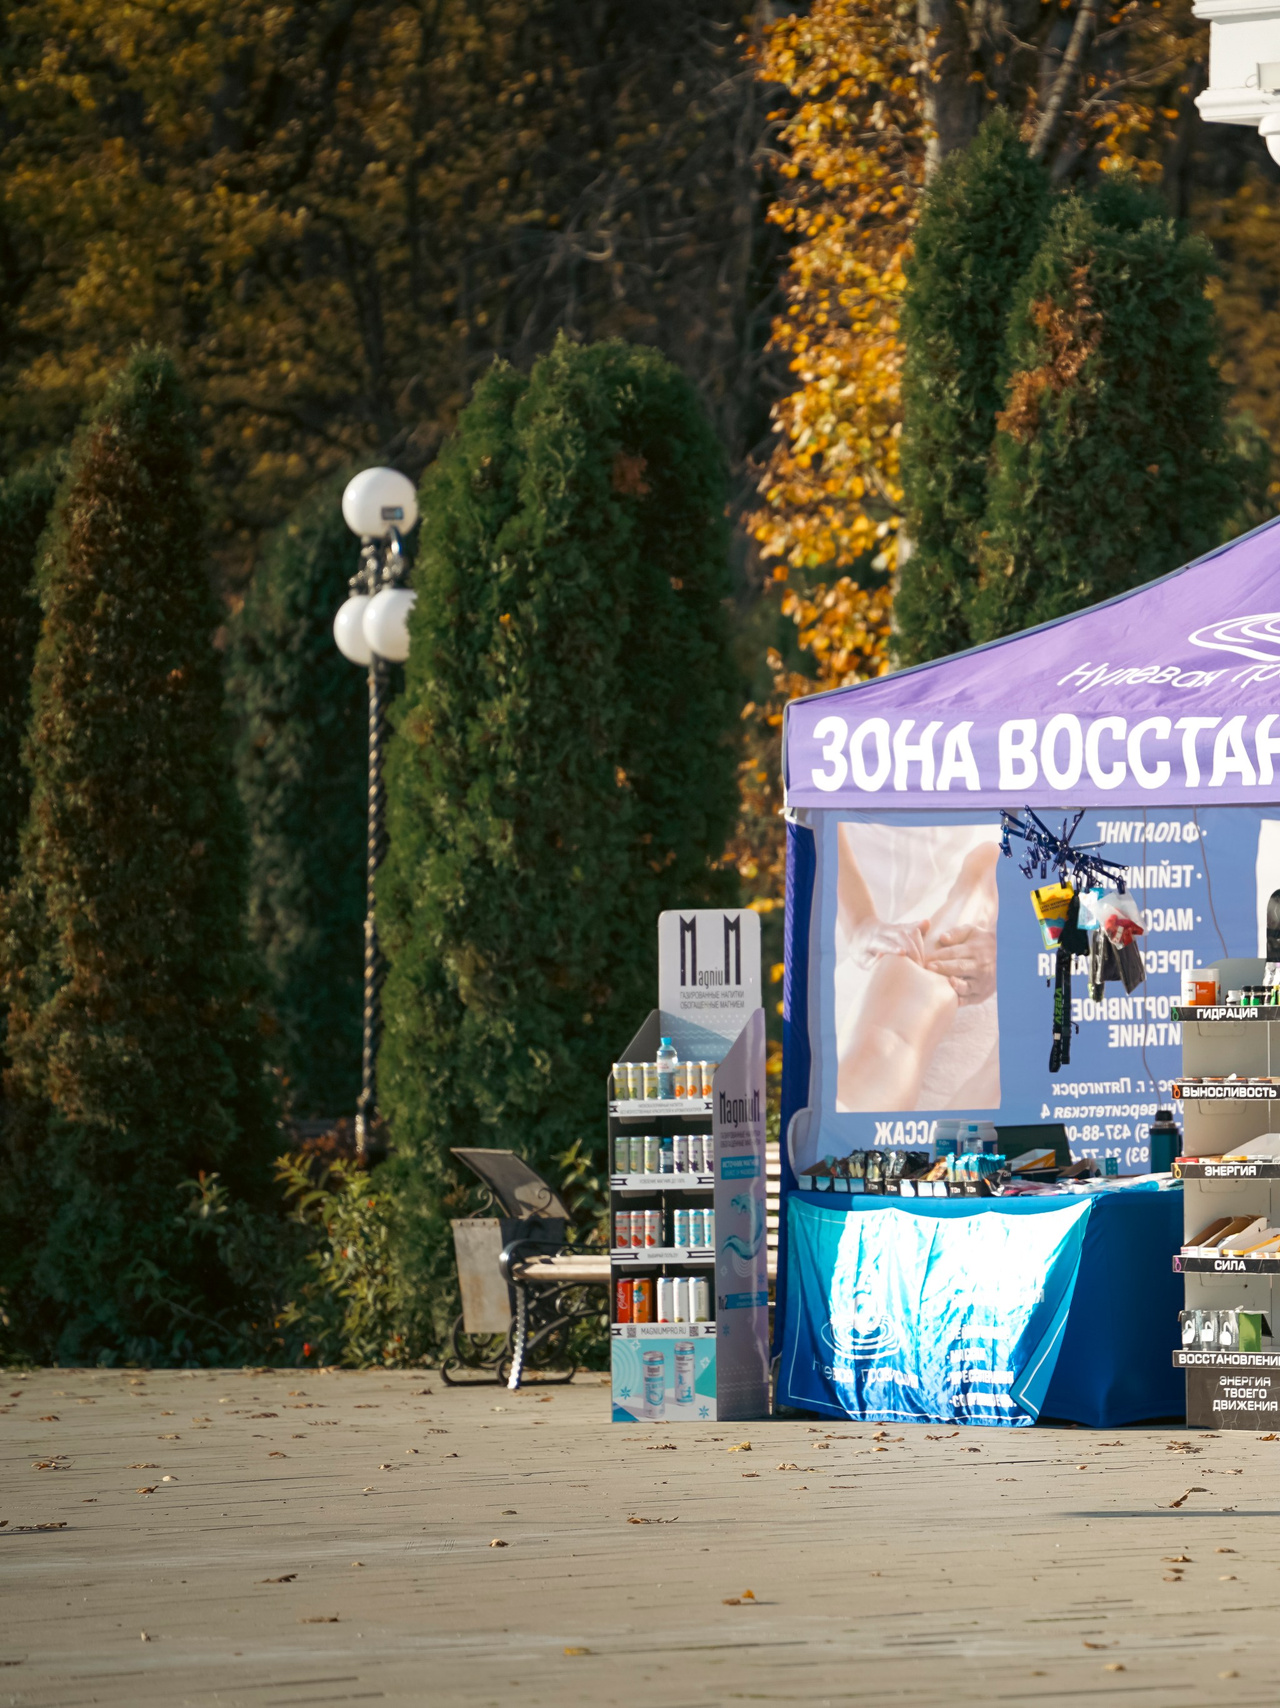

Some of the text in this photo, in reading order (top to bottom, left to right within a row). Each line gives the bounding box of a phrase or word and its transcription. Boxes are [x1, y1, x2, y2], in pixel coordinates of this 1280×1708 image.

[1056, 662, 1230, 693] Нулевая
[811, 715, 982, 792] ЗОНА
[1196, 1008, 1258, 1020] ГИДРАЦИЯ
[1182, 1087, 1277, 1098] ВЫНОСЛИВОСТЬ
[1205, 1165, 1257, 1176] ЭНЕРГИЯ
[1214, 1260, 1246, 1271] СИЛА
[1220, 1376, 1271, 1387] ЭНЕРГИЯ
[1224, 1388, 1267, 1398] ТВОЕГО
[1213, 1400, 1278, 1411] ДВИЖЕНИЯ
